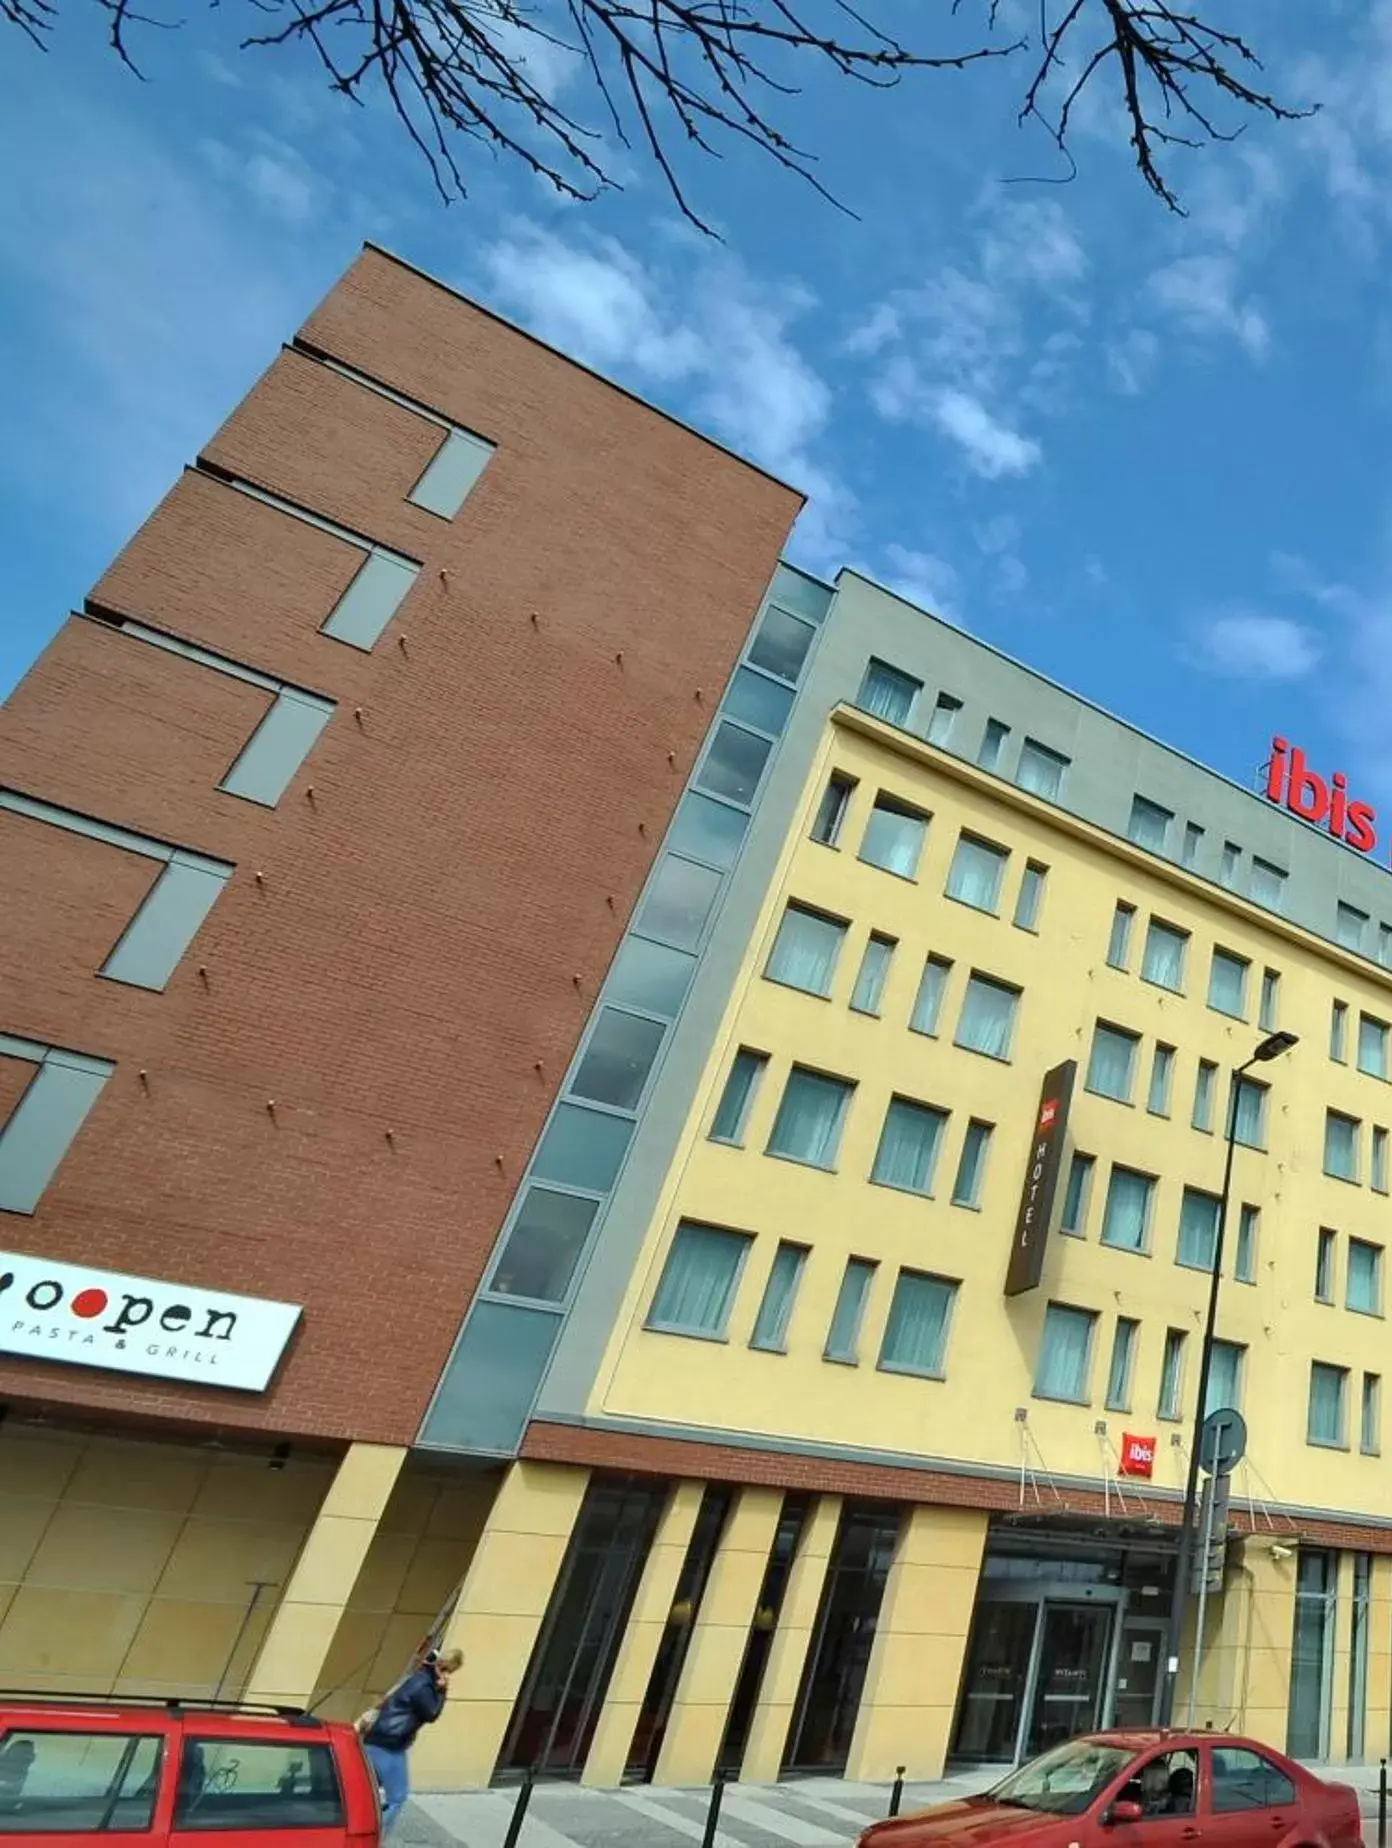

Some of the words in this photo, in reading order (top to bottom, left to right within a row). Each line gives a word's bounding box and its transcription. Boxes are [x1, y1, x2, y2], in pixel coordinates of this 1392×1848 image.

[1266, 735, 1377, 853] ibis
[1021, 1142, 1047, 1248] HOTEL
[11, 1320, 96, 1345] PASTA
[115, 1338, 127, 1350] &
[146, 1343, 220, 1365] GRILL
